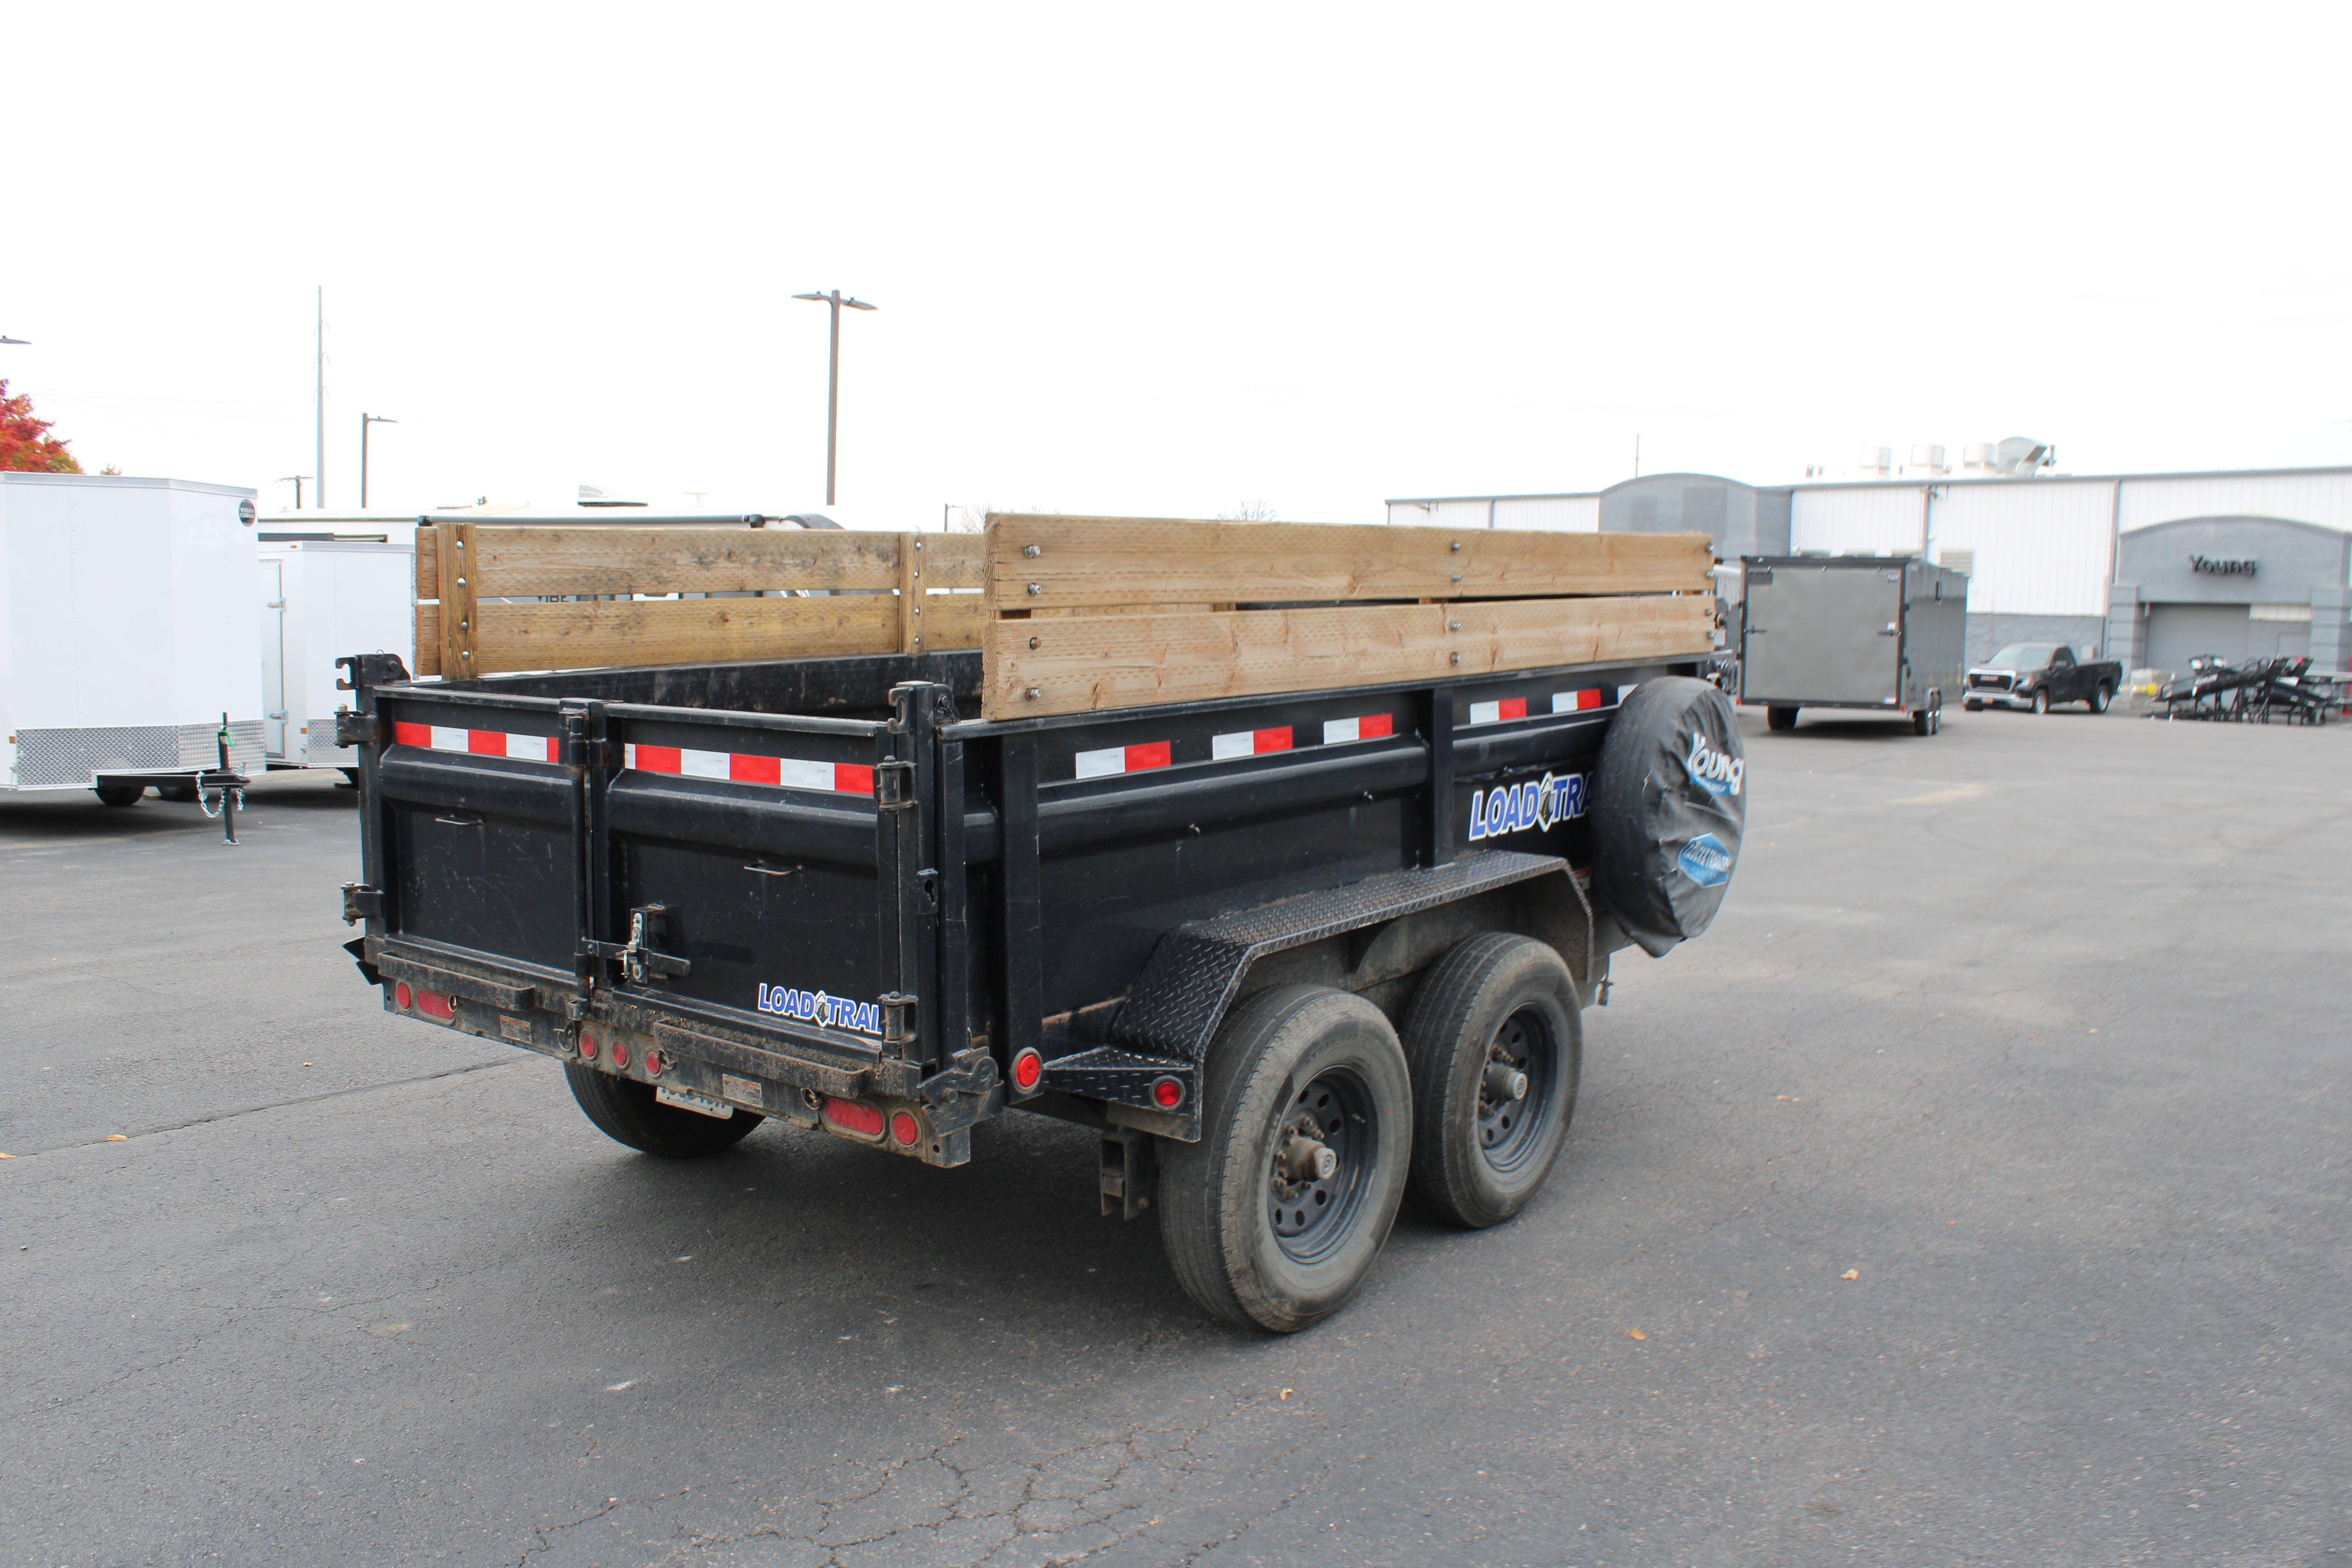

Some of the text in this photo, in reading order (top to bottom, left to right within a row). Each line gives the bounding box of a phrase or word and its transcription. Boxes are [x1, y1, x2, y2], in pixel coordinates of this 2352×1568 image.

[2189, 554, 2256, 577] Young
[1687, 732, 1745, 795] Young
[1469, 781, 1541, 841] LOAD
[758, 982, 882, 1035] LOAD TRAI
